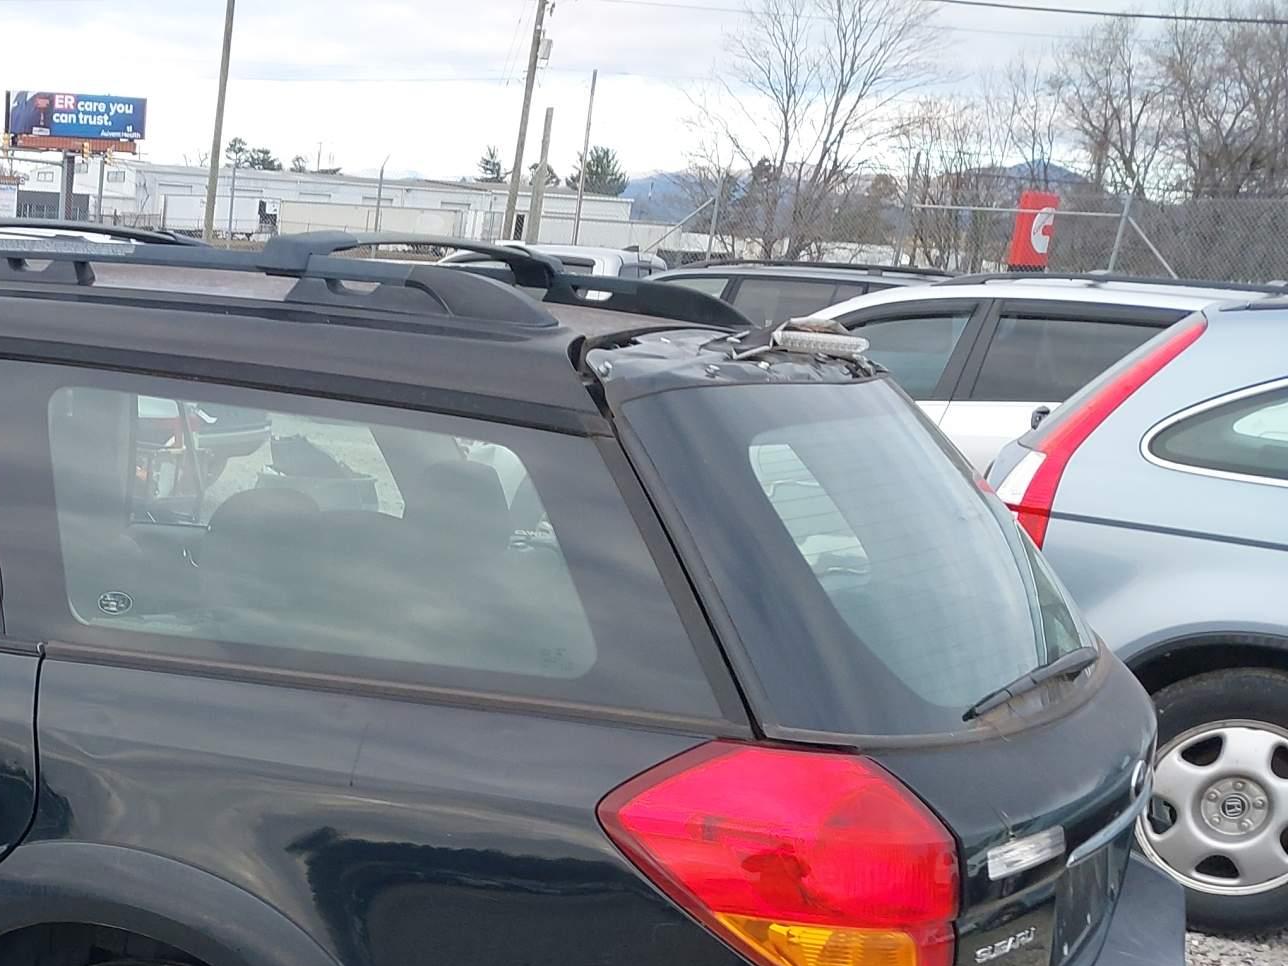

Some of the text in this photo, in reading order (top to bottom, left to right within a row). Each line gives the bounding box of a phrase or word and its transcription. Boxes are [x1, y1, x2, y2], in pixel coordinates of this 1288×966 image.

[54, 94, 75, 109] ER
[77, 100, 106, 112] care
[109, 102, 133, 116] you
[52, 112, 112, 126] can trust.
[974, 926, 1036, 964] SUBARU
